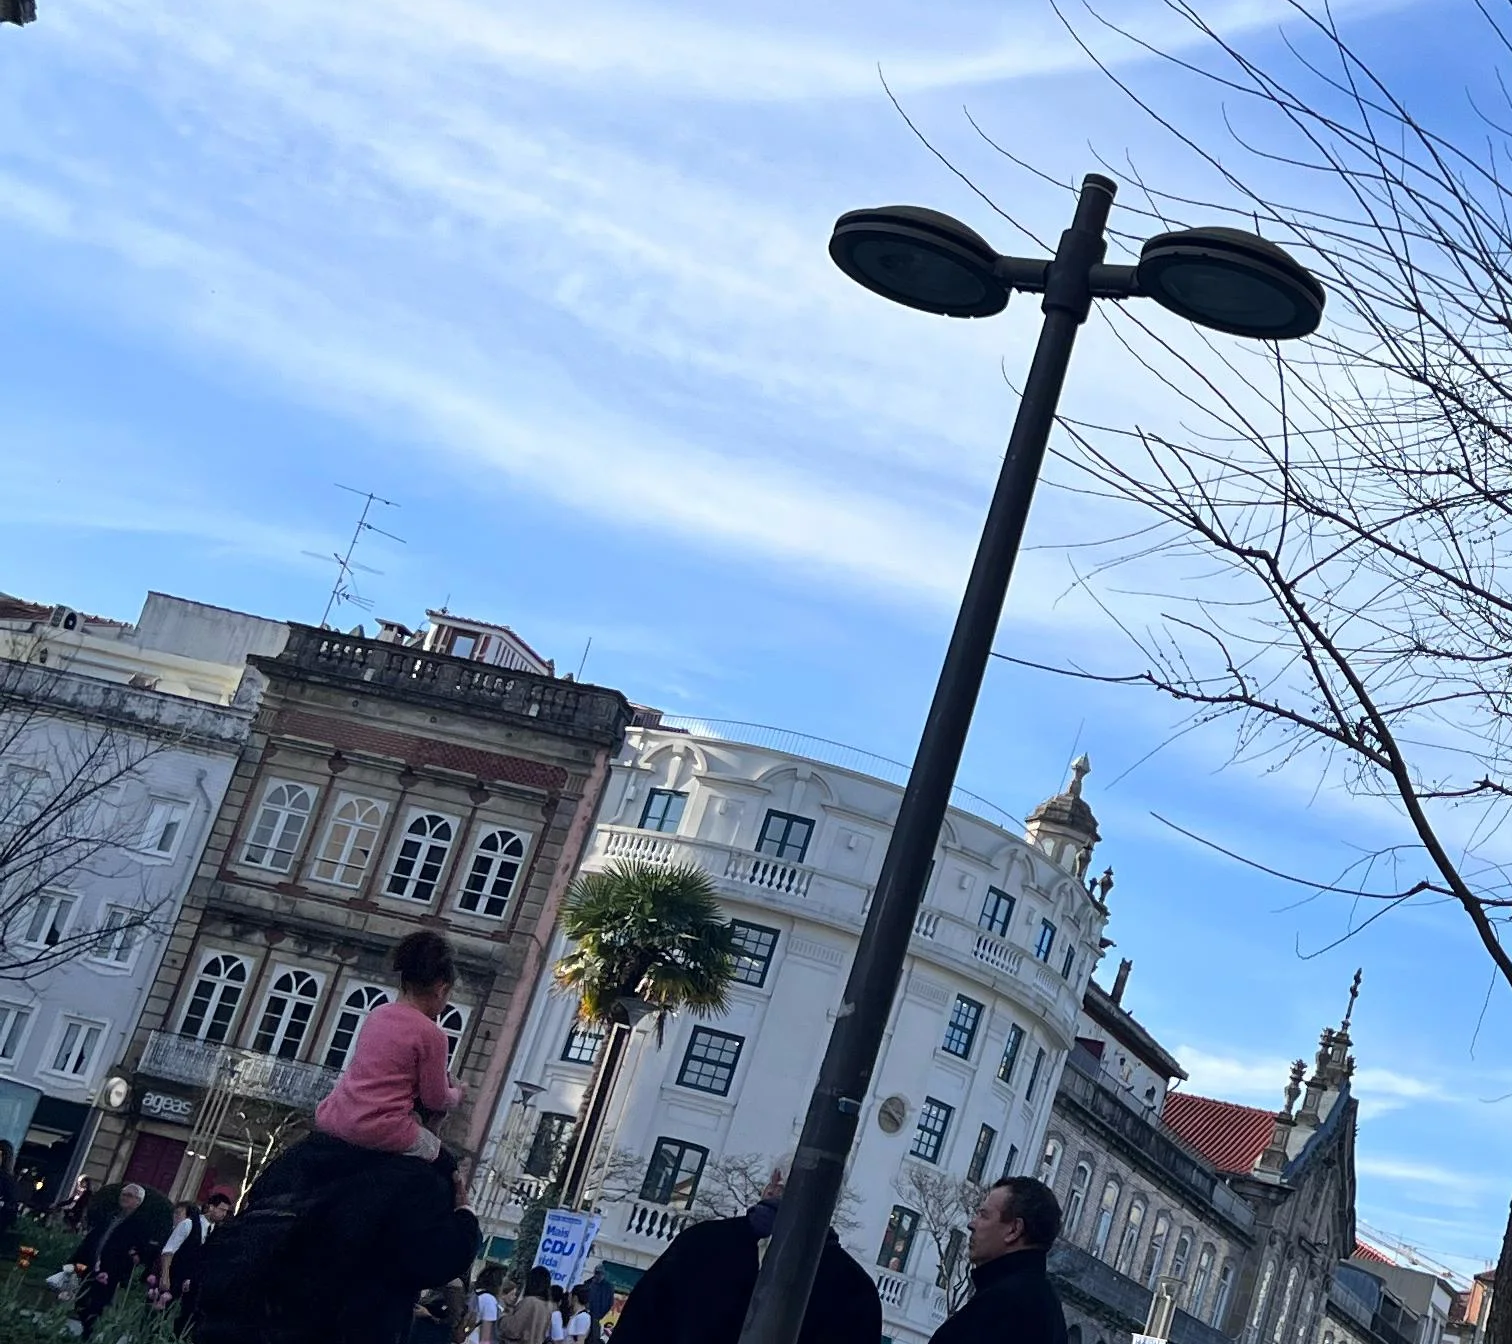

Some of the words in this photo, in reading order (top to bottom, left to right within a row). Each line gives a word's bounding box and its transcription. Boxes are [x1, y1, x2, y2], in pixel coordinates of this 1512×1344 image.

[142, 1092, 192, 1115] ageas
[546, 1225, 569, 1238] Mais
[541, 1238, 576, 1256] CDU
